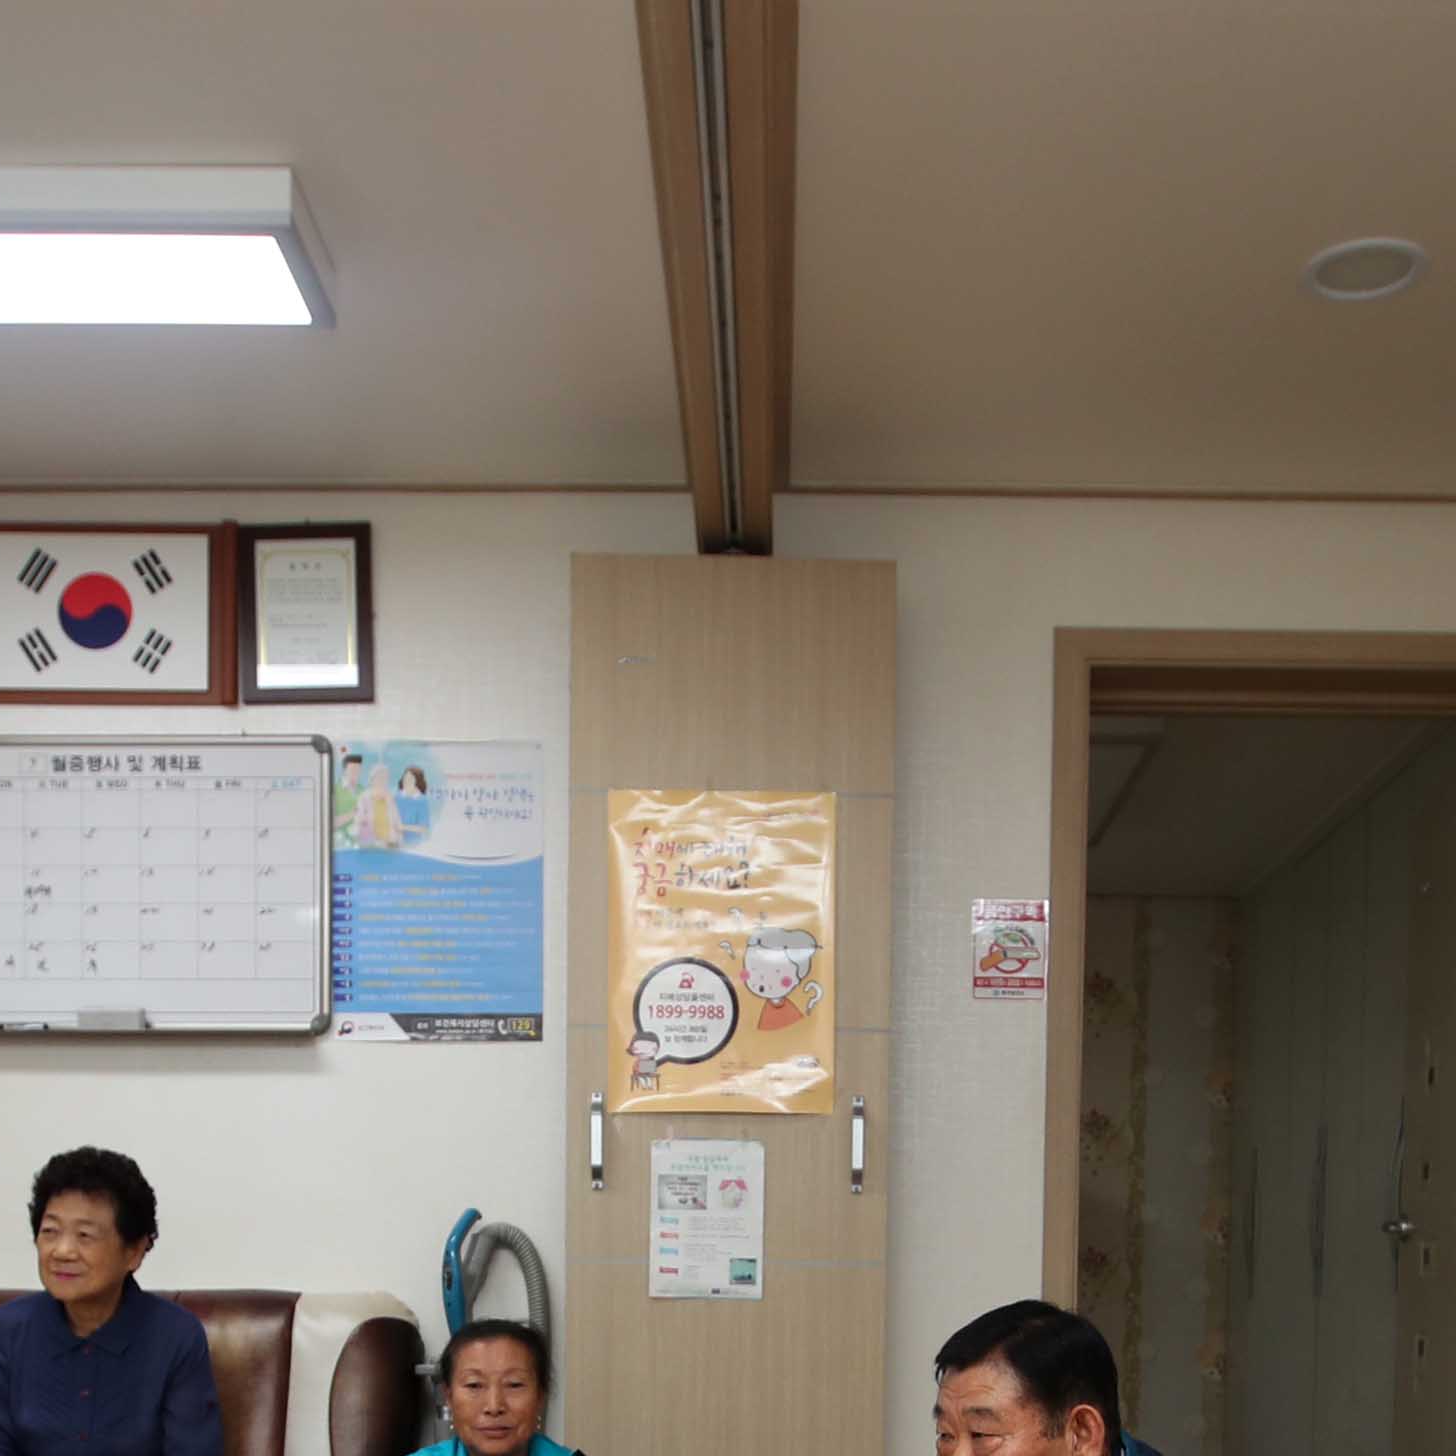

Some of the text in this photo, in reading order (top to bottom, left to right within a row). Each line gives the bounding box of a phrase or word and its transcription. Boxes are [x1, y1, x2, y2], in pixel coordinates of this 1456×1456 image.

[52, 754, 120, 773] 월중행사
[127, 754, 144, 772] 및
[152, 754, 202, 772] 계획표
[648, 1004, 725, 1020] 1899-9988
